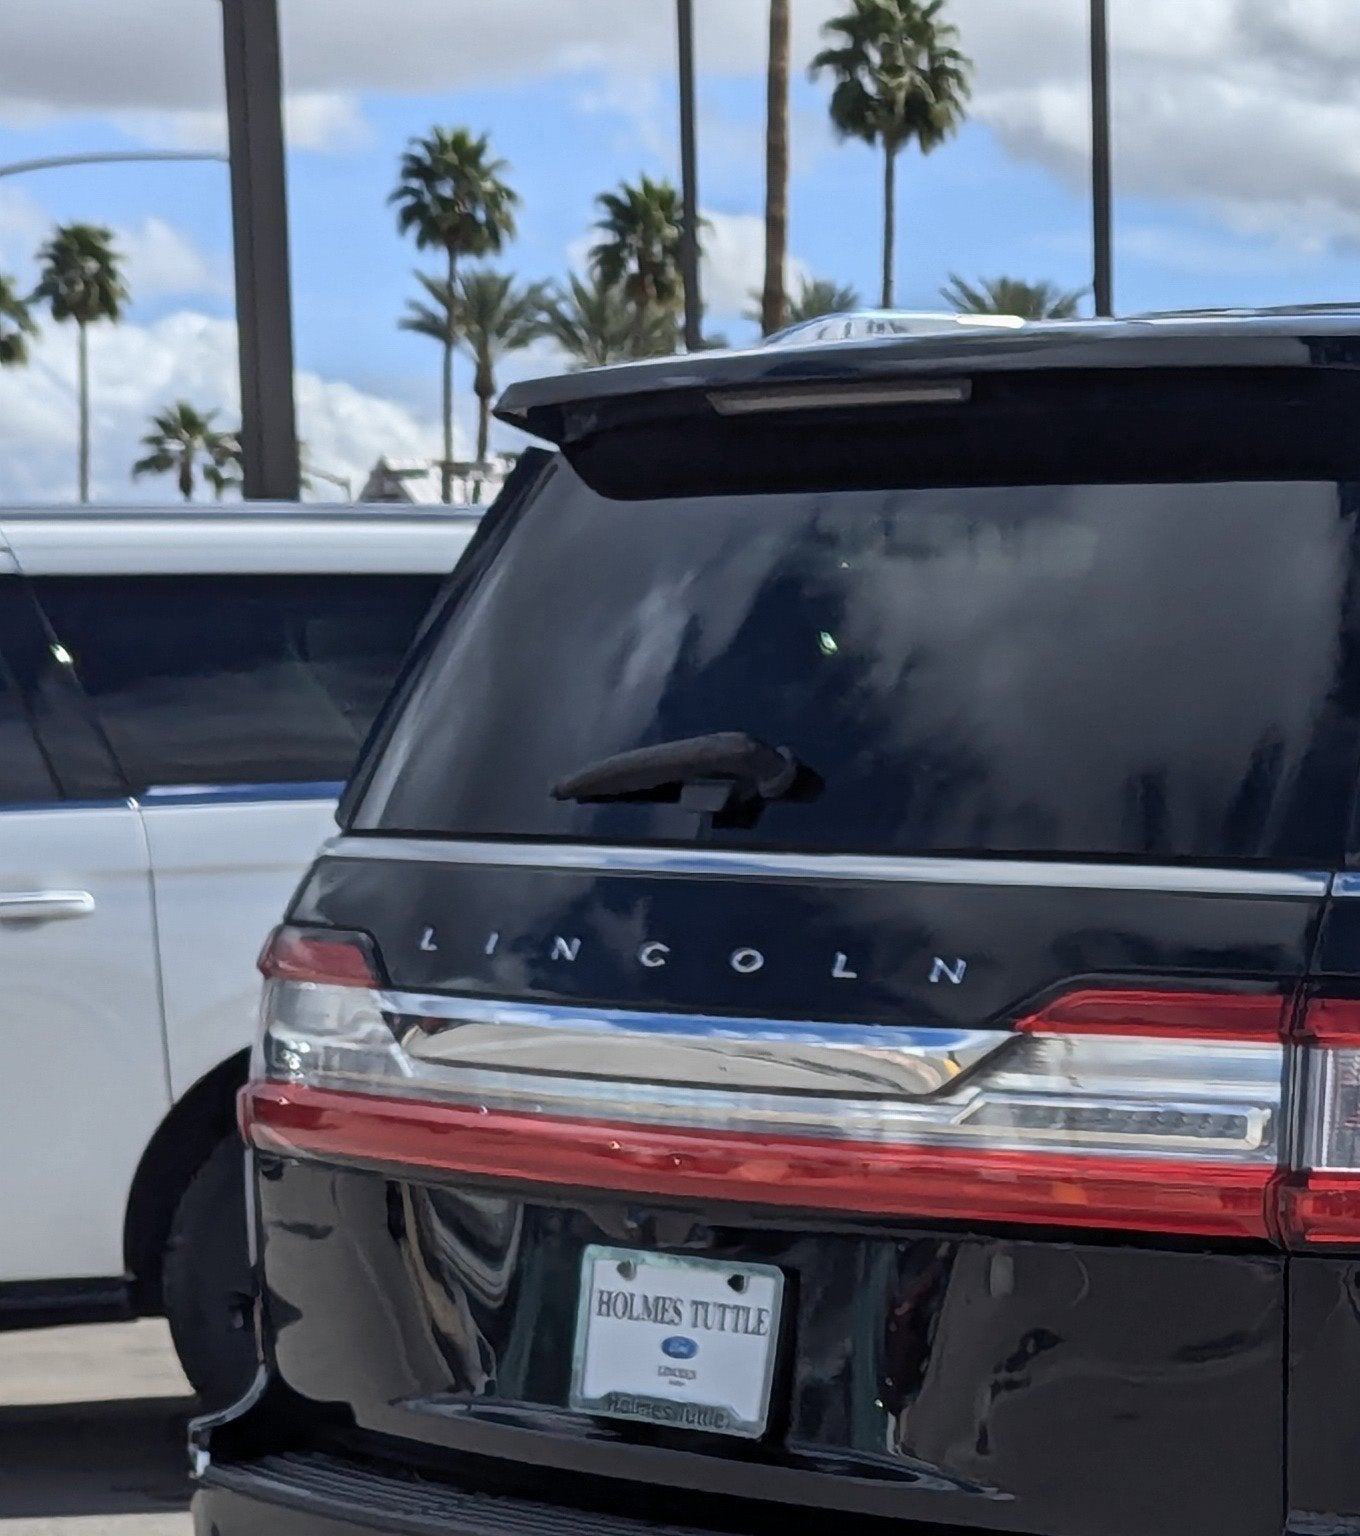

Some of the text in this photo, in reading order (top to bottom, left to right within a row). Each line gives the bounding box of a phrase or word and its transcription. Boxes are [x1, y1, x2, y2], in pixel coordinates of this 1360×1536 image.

[419, 926, 967, 985] LINCOLN
[596, 1289, 770, 1336] HOLMES TUTTLE
